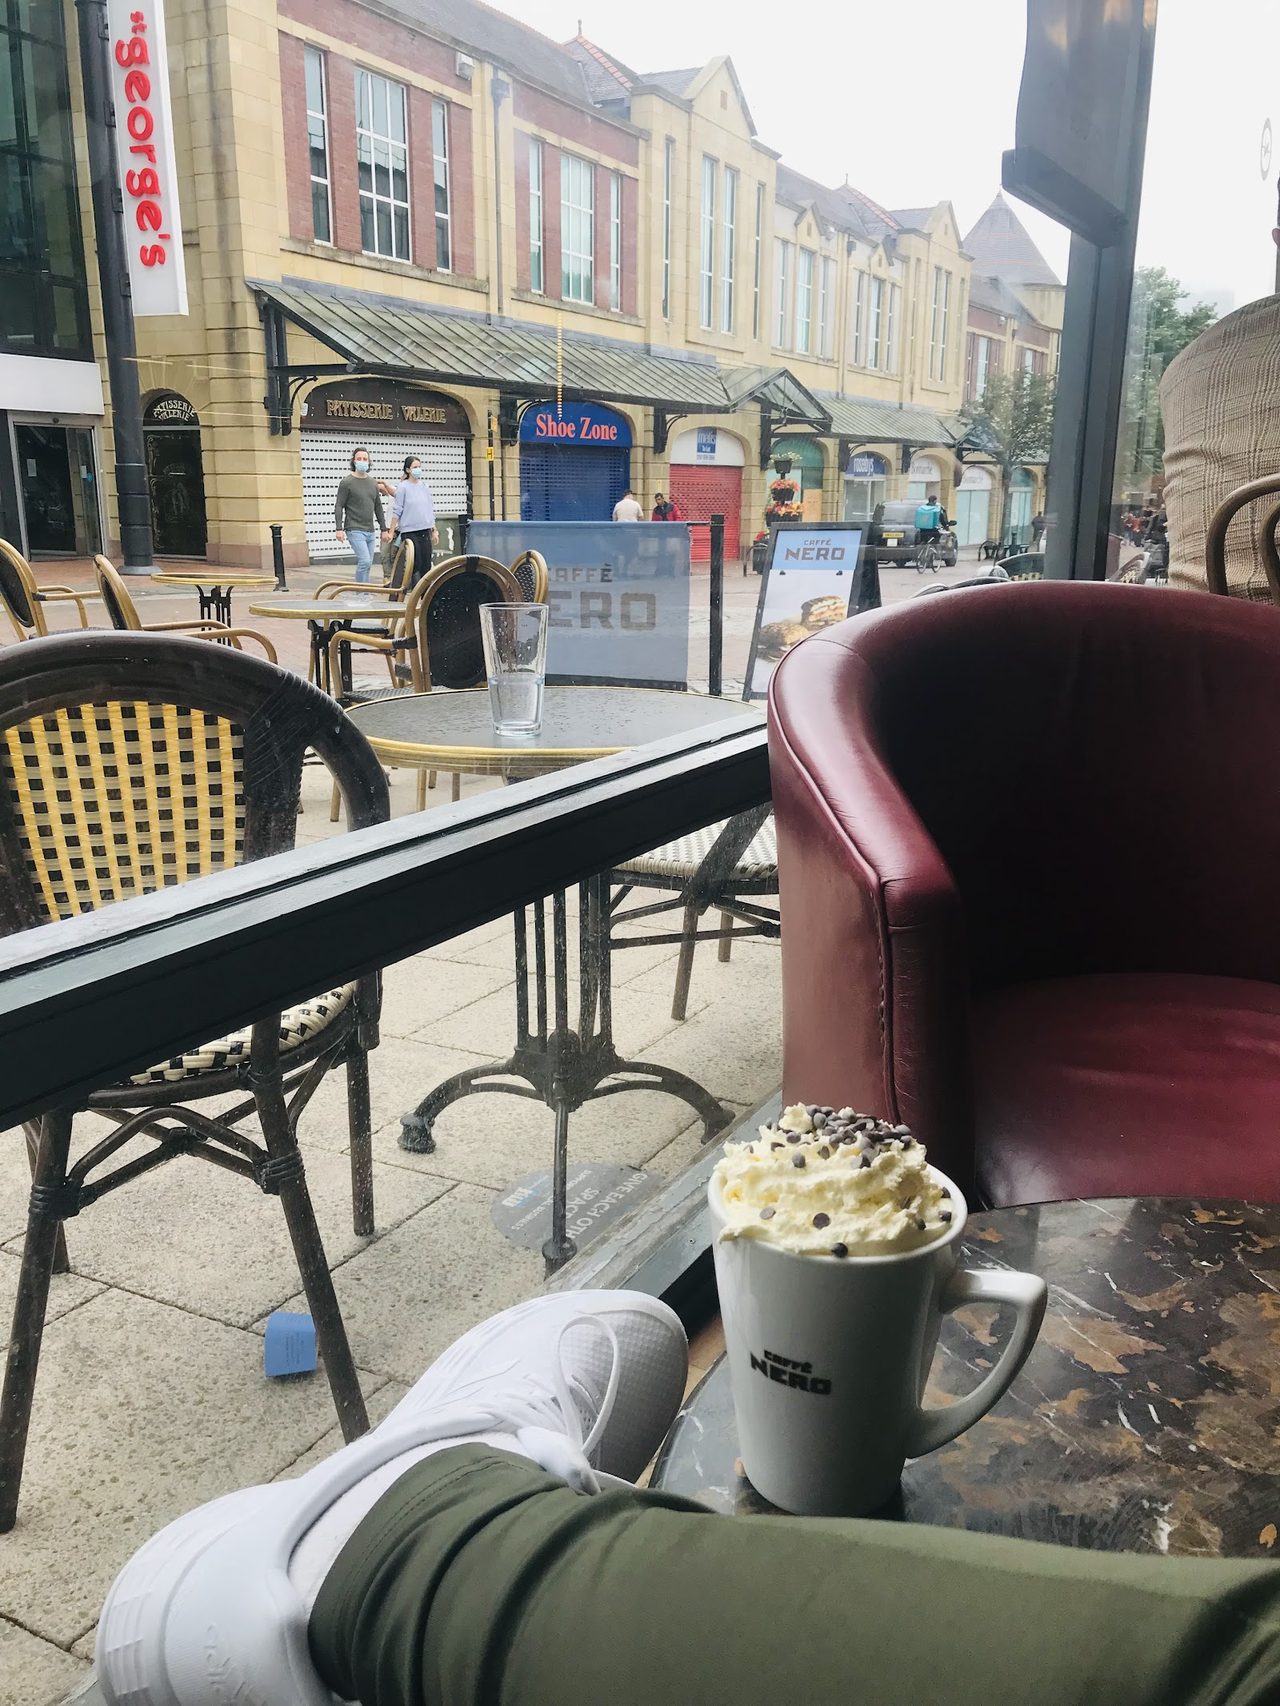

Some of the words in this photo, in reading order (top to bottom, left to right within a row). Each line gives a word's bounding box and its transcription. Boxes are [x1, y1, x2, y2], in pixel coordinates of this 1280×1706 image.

[130, 11, 147, 34] st
[115, 36, 171, 268] george's
[158, 409, 191, 422] VALERIE
[326, 399, 394, 420] PATISSERIE
[401, 405, 447, 424] VALERIE
[536, 413, 576, 438] Shoe
[580, 416, 618, 441] Zone
[784, 547, 846, 561] NERO
[547, 563, 613, 583] AFFÈ
[547, 590, 657, 631] ERO
[615, 1173, 648, 1193] GIVE
[586, 1191, 625, 1218] EACH
[566, 1217, 593, 1239] OTH
[750, 1352, 832, 1395] NERO
